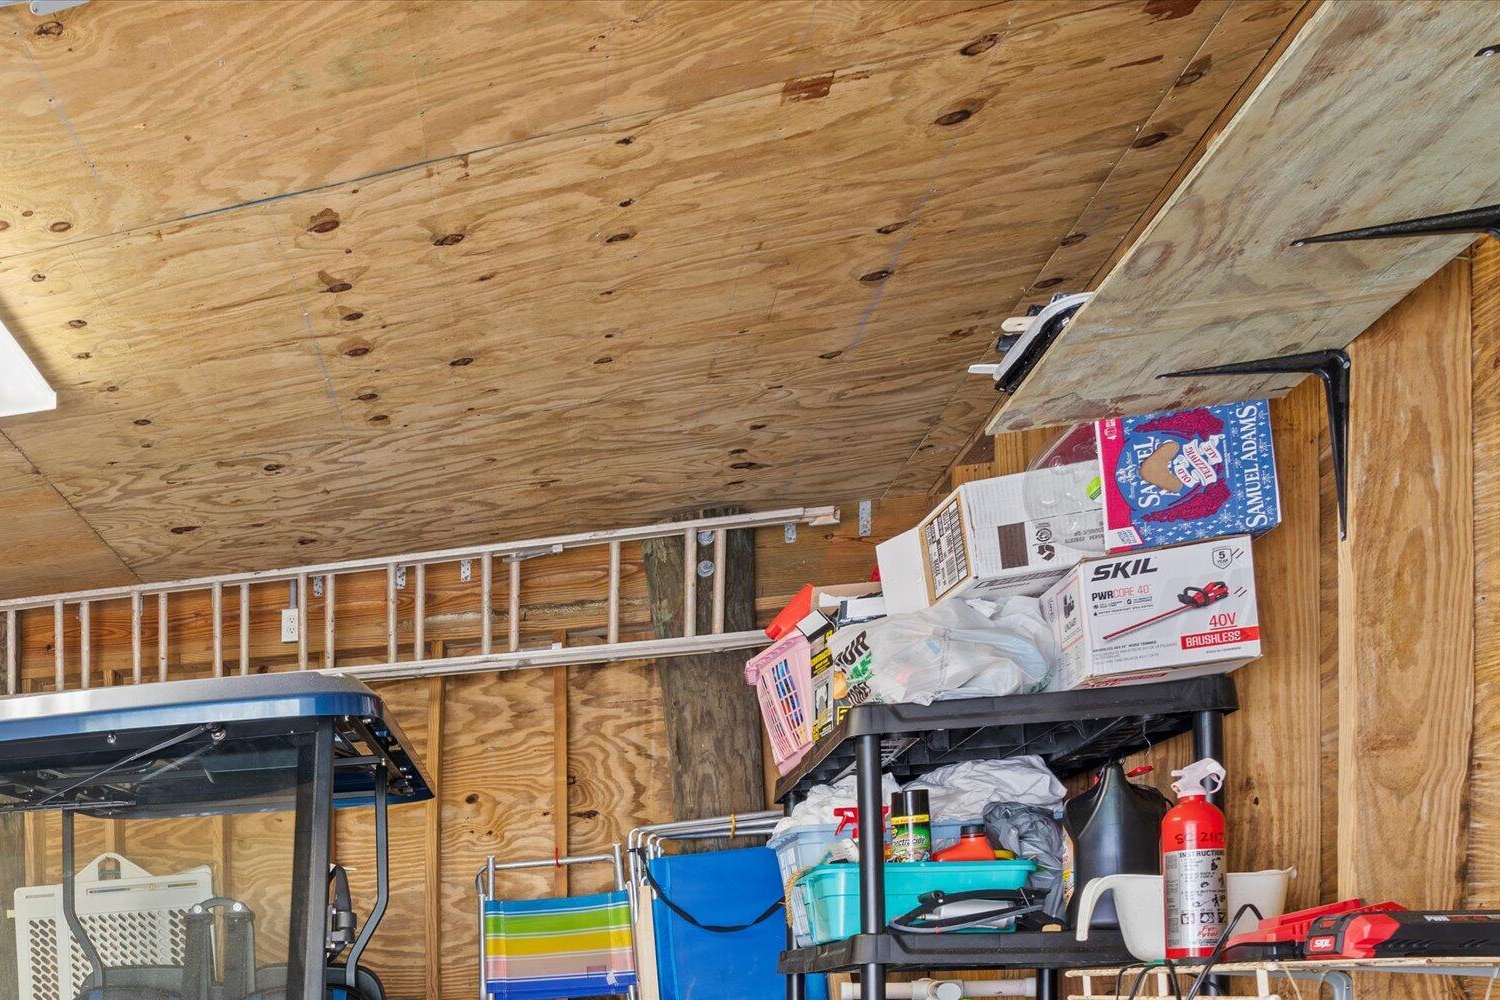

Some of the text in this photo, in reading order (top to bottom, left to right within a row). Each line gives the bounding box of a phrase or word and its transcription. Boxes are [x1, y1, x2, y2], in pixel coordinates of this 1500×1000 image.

[1203, 444, 1218, 461] ALE
[1133, 436, 1162, 508] SAEL
[1185, 446, 1214, 480] FEZZIWIG
[1235, 404, 1268, 528] SAMUEL ADAMS
[1177, 466, 1193, 484] OLD
[1218, 550, 1226, 560] 5
[1091, 557, 1158, 582] SKIL
[1208, 611, 1237, 628] 40V
[1185, 631, 1242, 647] BRUSHLESS
